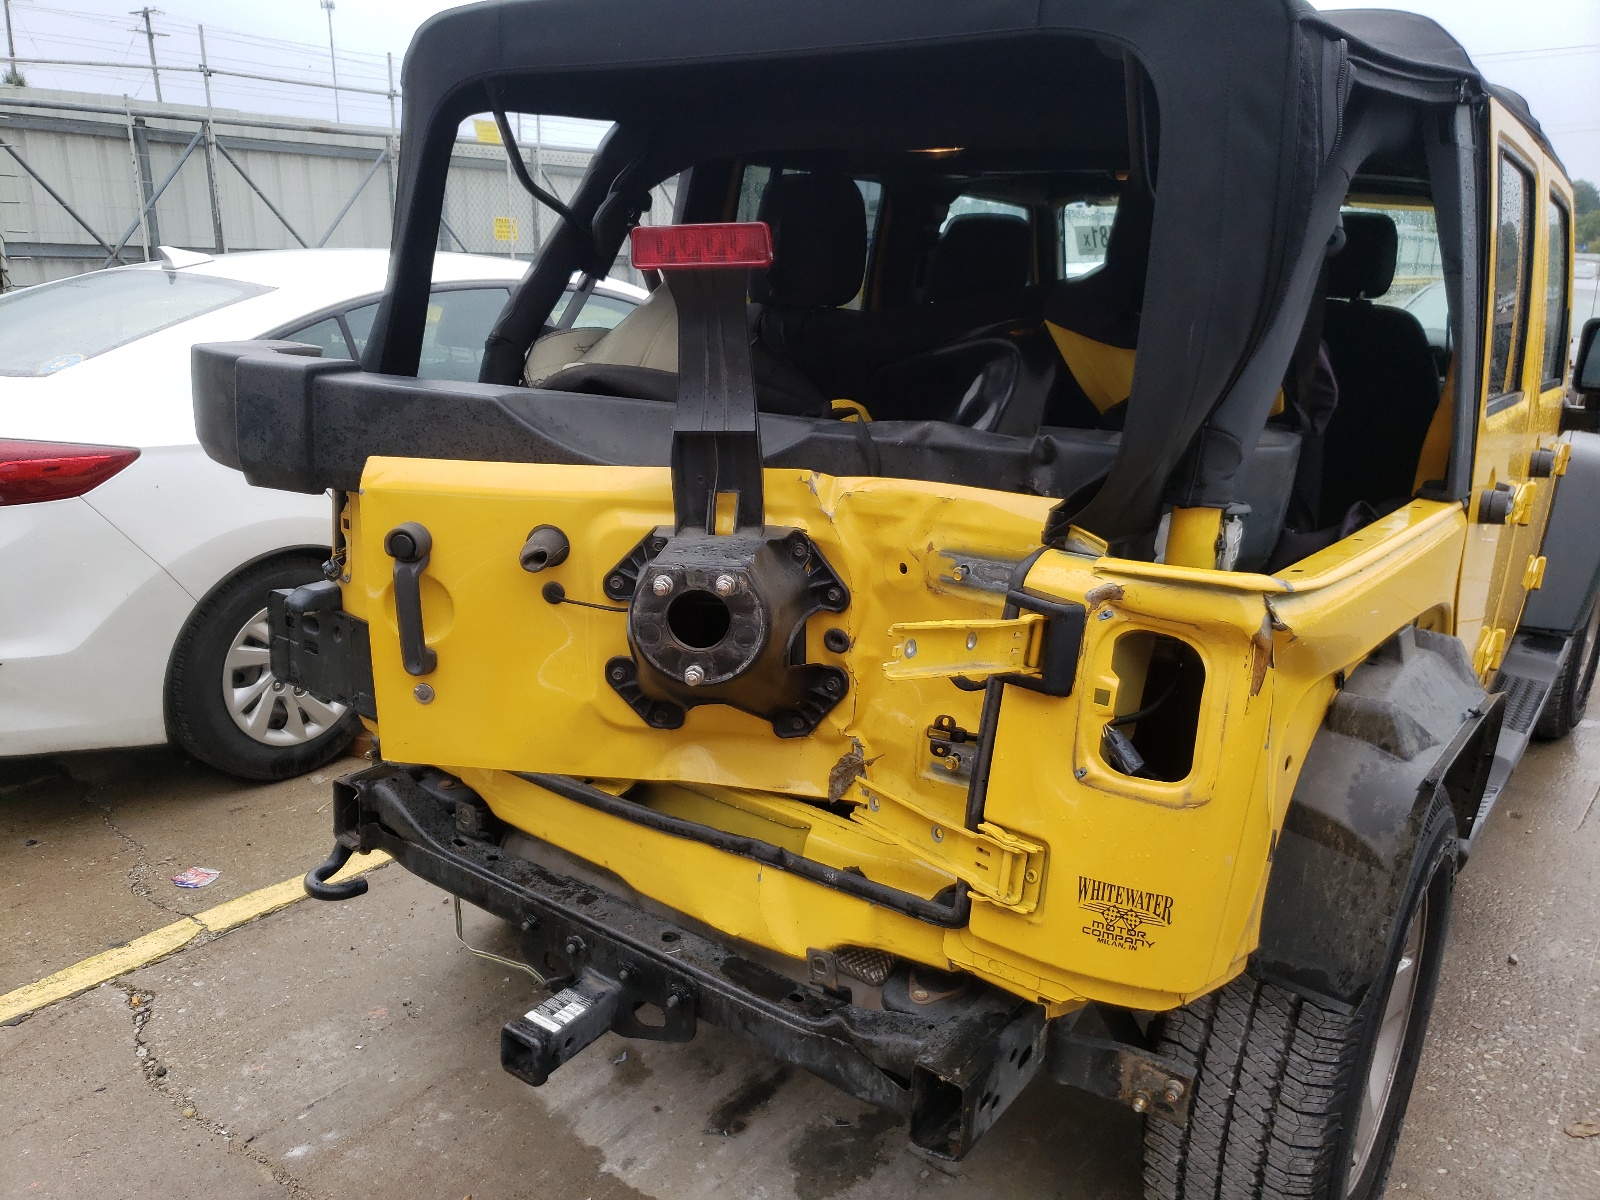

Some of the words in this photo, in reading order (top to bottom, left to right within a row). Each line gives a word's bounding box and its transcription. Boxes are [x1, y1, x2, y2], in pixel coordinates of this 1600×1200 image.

[1078, 875, 1173, 925] WHITEWATER
[1082, 926, 1156, 948] COMPANY
[1092, 920, 1147, 939] MOTOR
[1097, 937, 1126, 950] MILAN,
